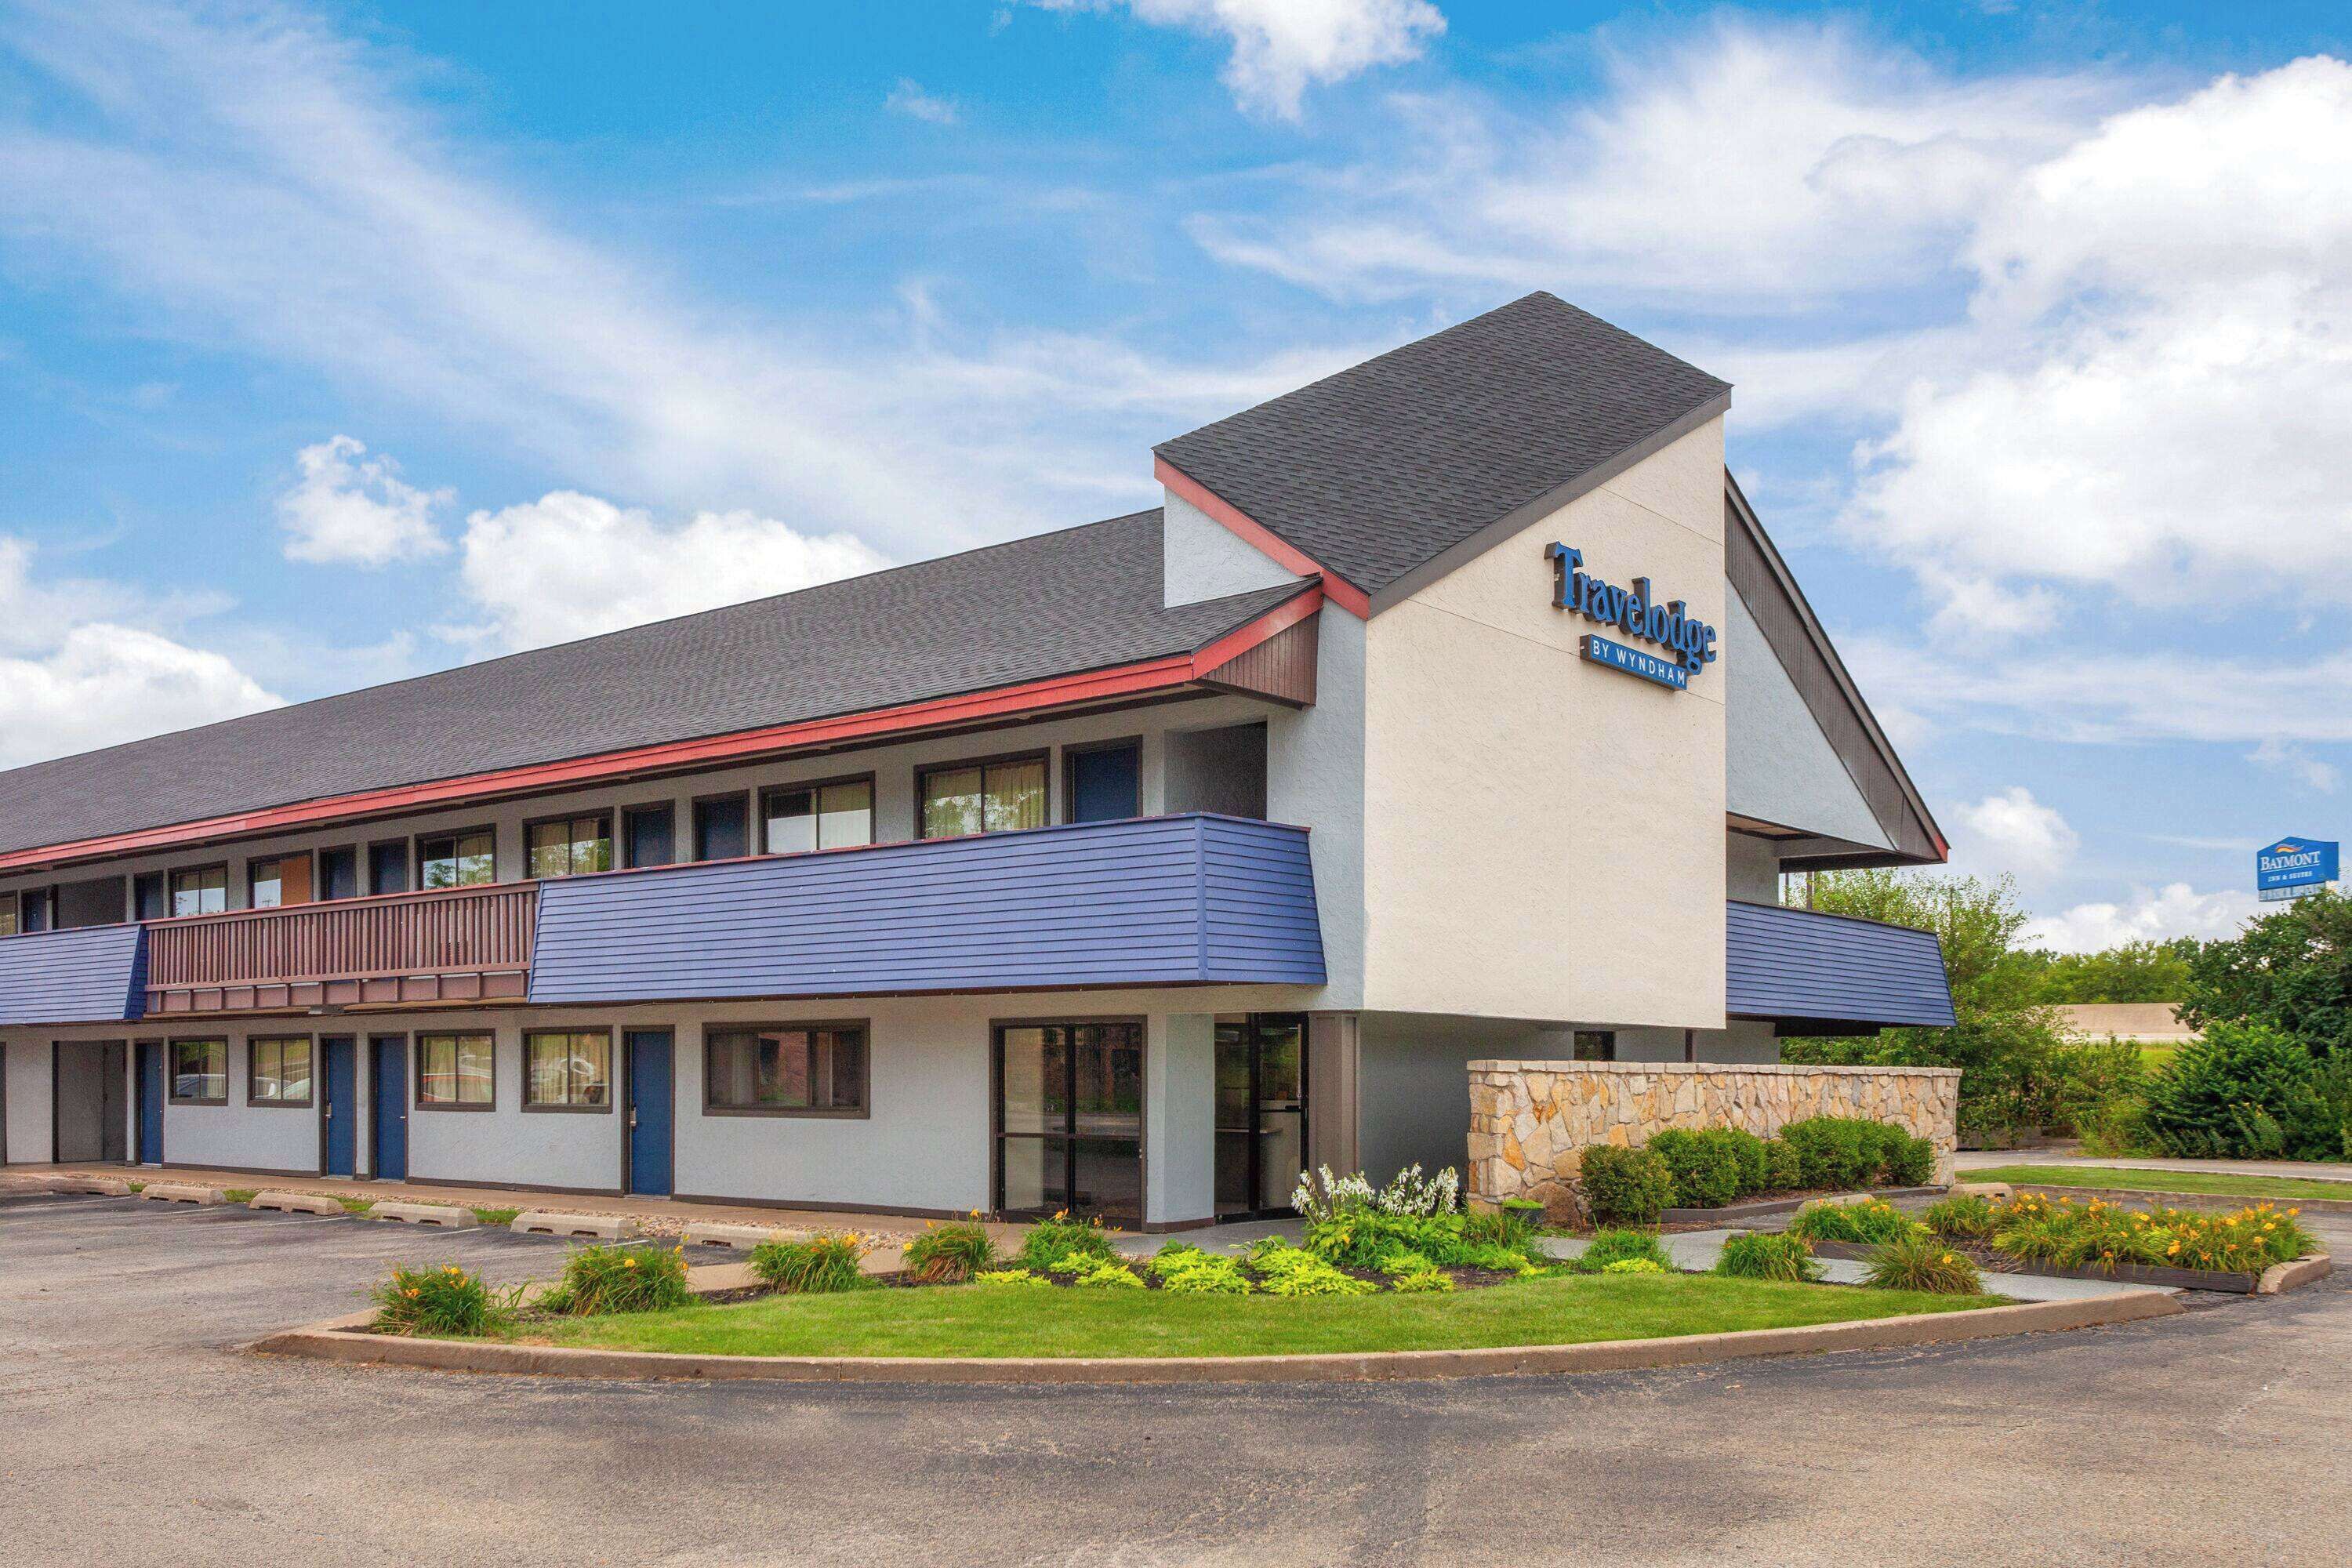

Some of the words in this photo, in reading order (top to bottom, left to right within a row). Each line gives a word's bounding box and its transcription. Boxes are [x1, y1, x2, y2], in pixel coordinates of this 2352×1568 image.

[1544, 541, 1717, 675] Travelodge
[1593, 640, 1609, 658] BY
[1617, 648, 1685, 685] WYNDHAM
[2260, 851, 2321, 871] BAYMONT
